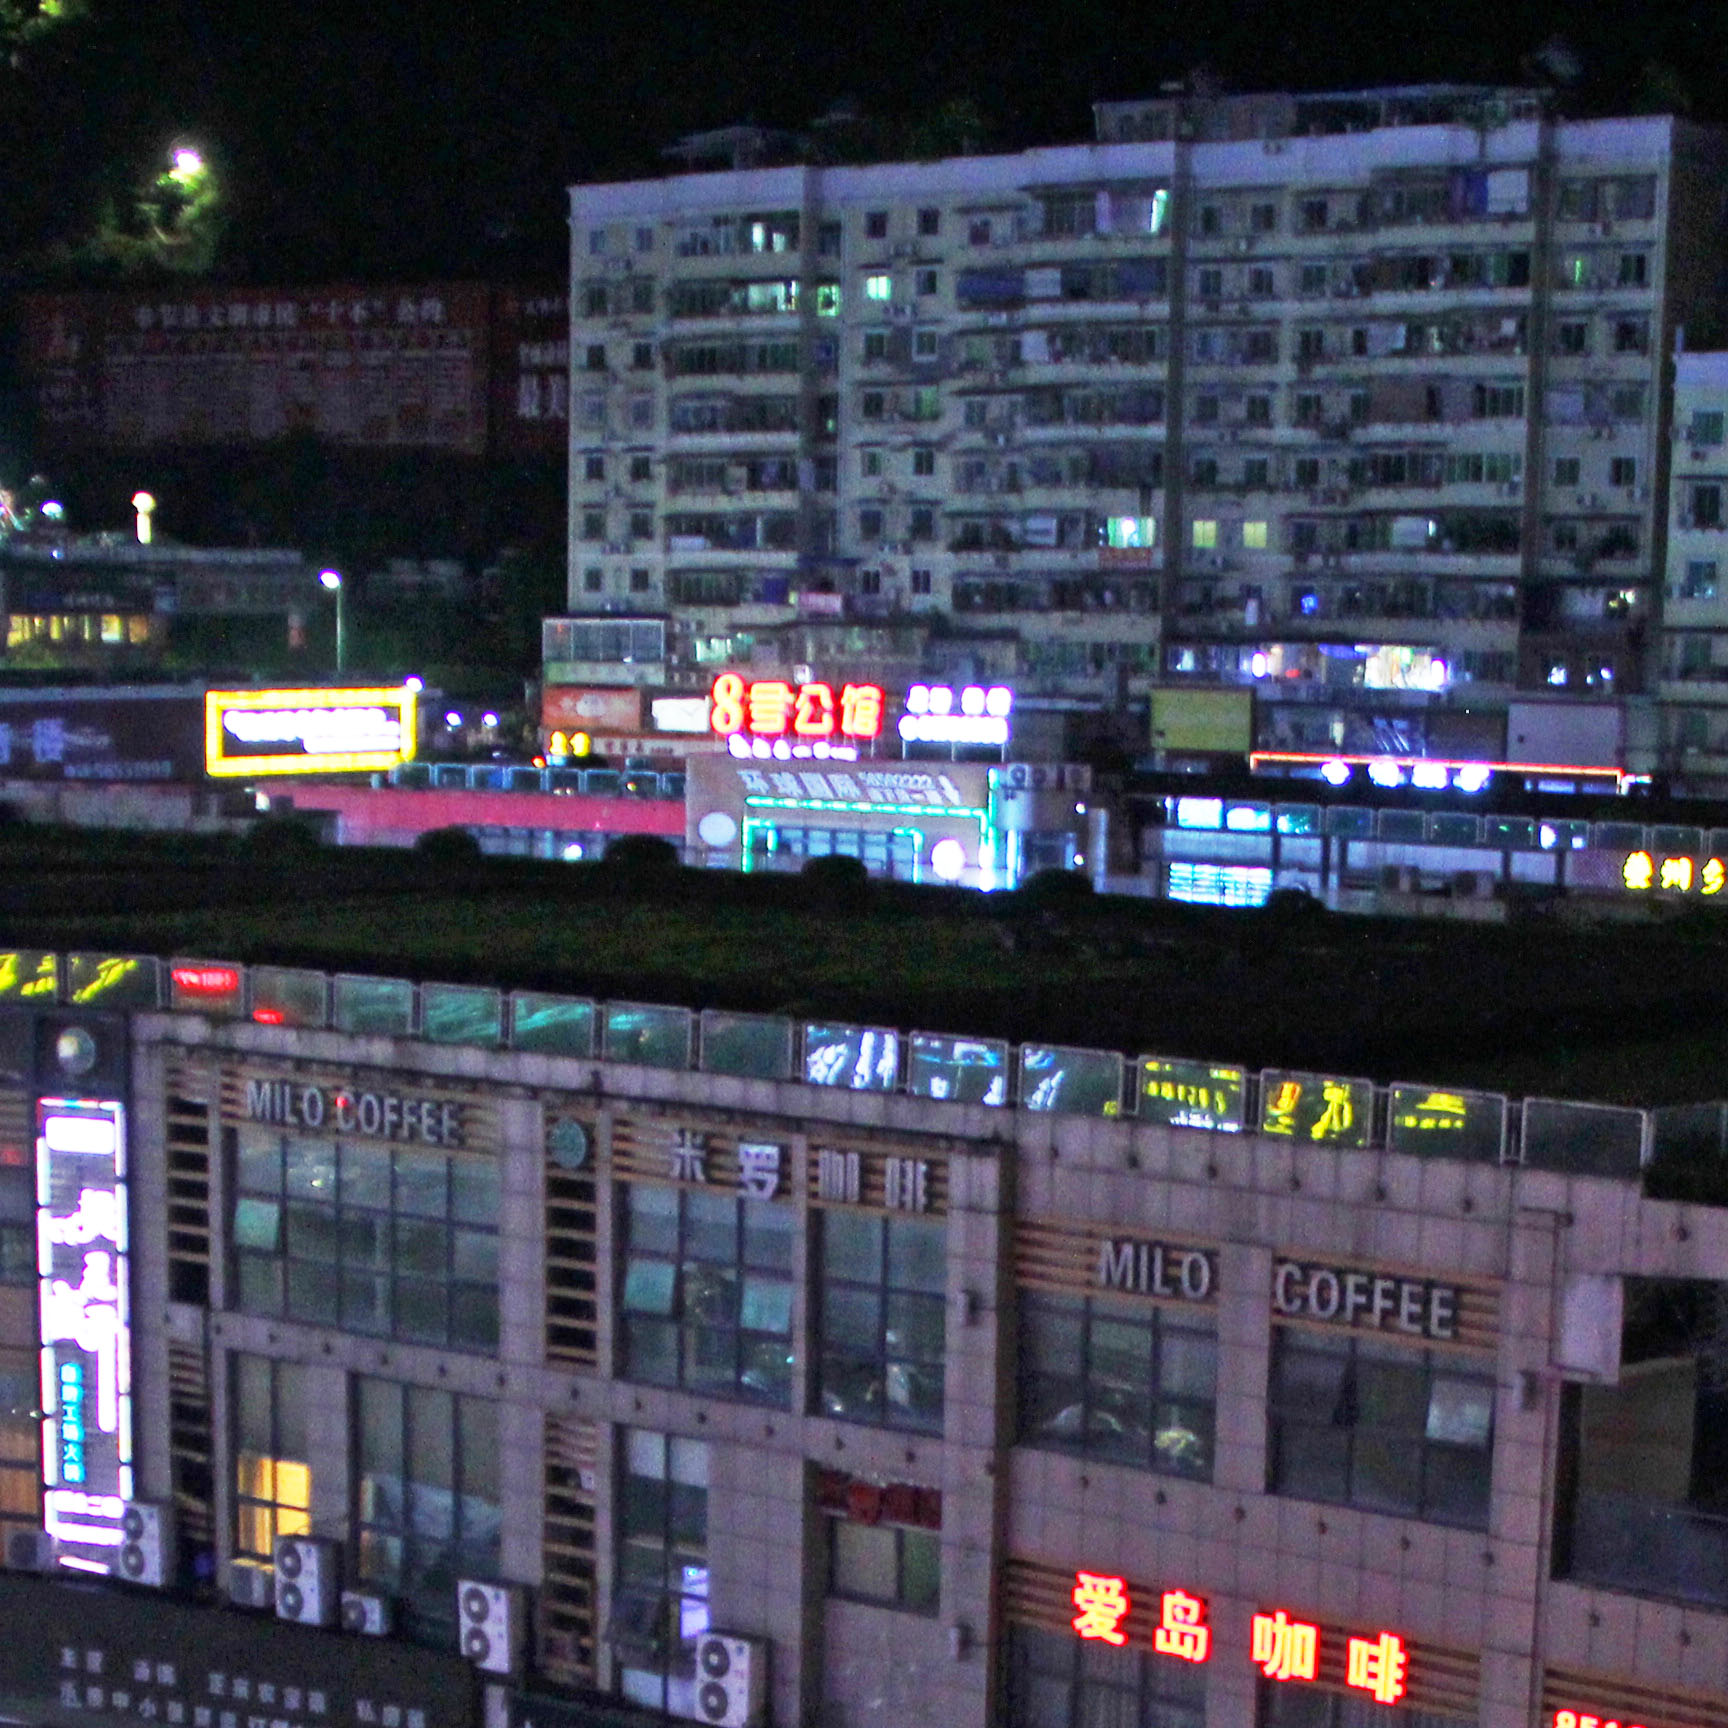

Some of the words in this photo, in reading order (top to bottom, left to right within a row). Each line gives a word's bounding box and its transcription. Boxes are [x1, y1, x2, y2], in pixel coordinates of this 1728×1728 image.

[247, 1080, 323, 1127] MILO
[335, 1089, 459, 1147] COFFEE
[1099, 1240, 1210, 1299] MILO
[1274, 1262, 1455, 1339] COFFEE
[1072, 1570, 1405, 1704] 爱岛咖啡
